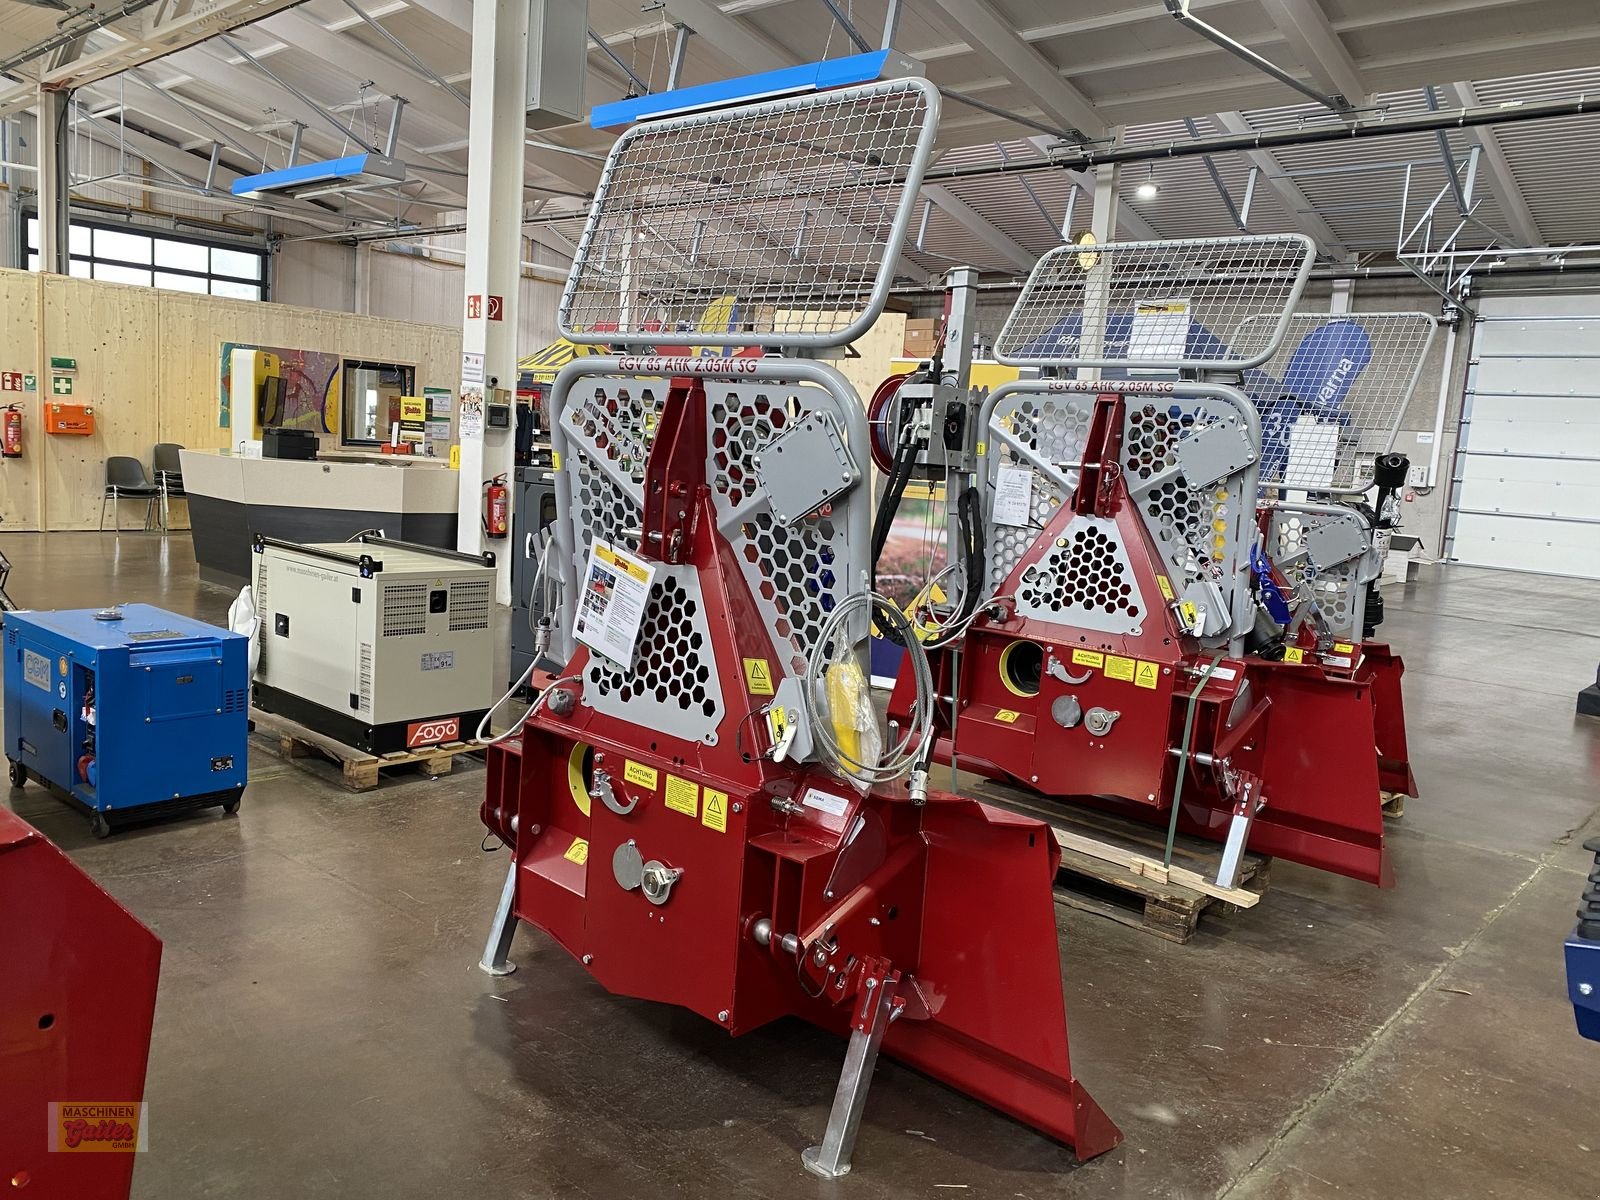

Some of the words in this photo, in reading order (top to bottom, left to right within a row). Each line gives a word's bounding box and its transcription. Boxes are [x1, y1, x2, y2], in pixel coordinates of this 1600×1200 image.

[618, 356, 644, 370] EGV
[646, 357, 661, 371] 85
[664, 358, 691, 373] AHK
[694, 358, 734, 373] 2.05M
[737, 359, 758, 373] SG
[1048, 381, 1072, 390] EGV
[1074, 382, 1088, 391] 65
[1091, 382, 1116, 392] AHK
[1119, 382, 1153, 392] 2.05M
[1156, 382, 1174, 392] SG
[1077, 652, 1100, 661] ACHTUNG
[440, 660, 448, 668] 91
[629, 766, 653, 780] ACHTUNG
